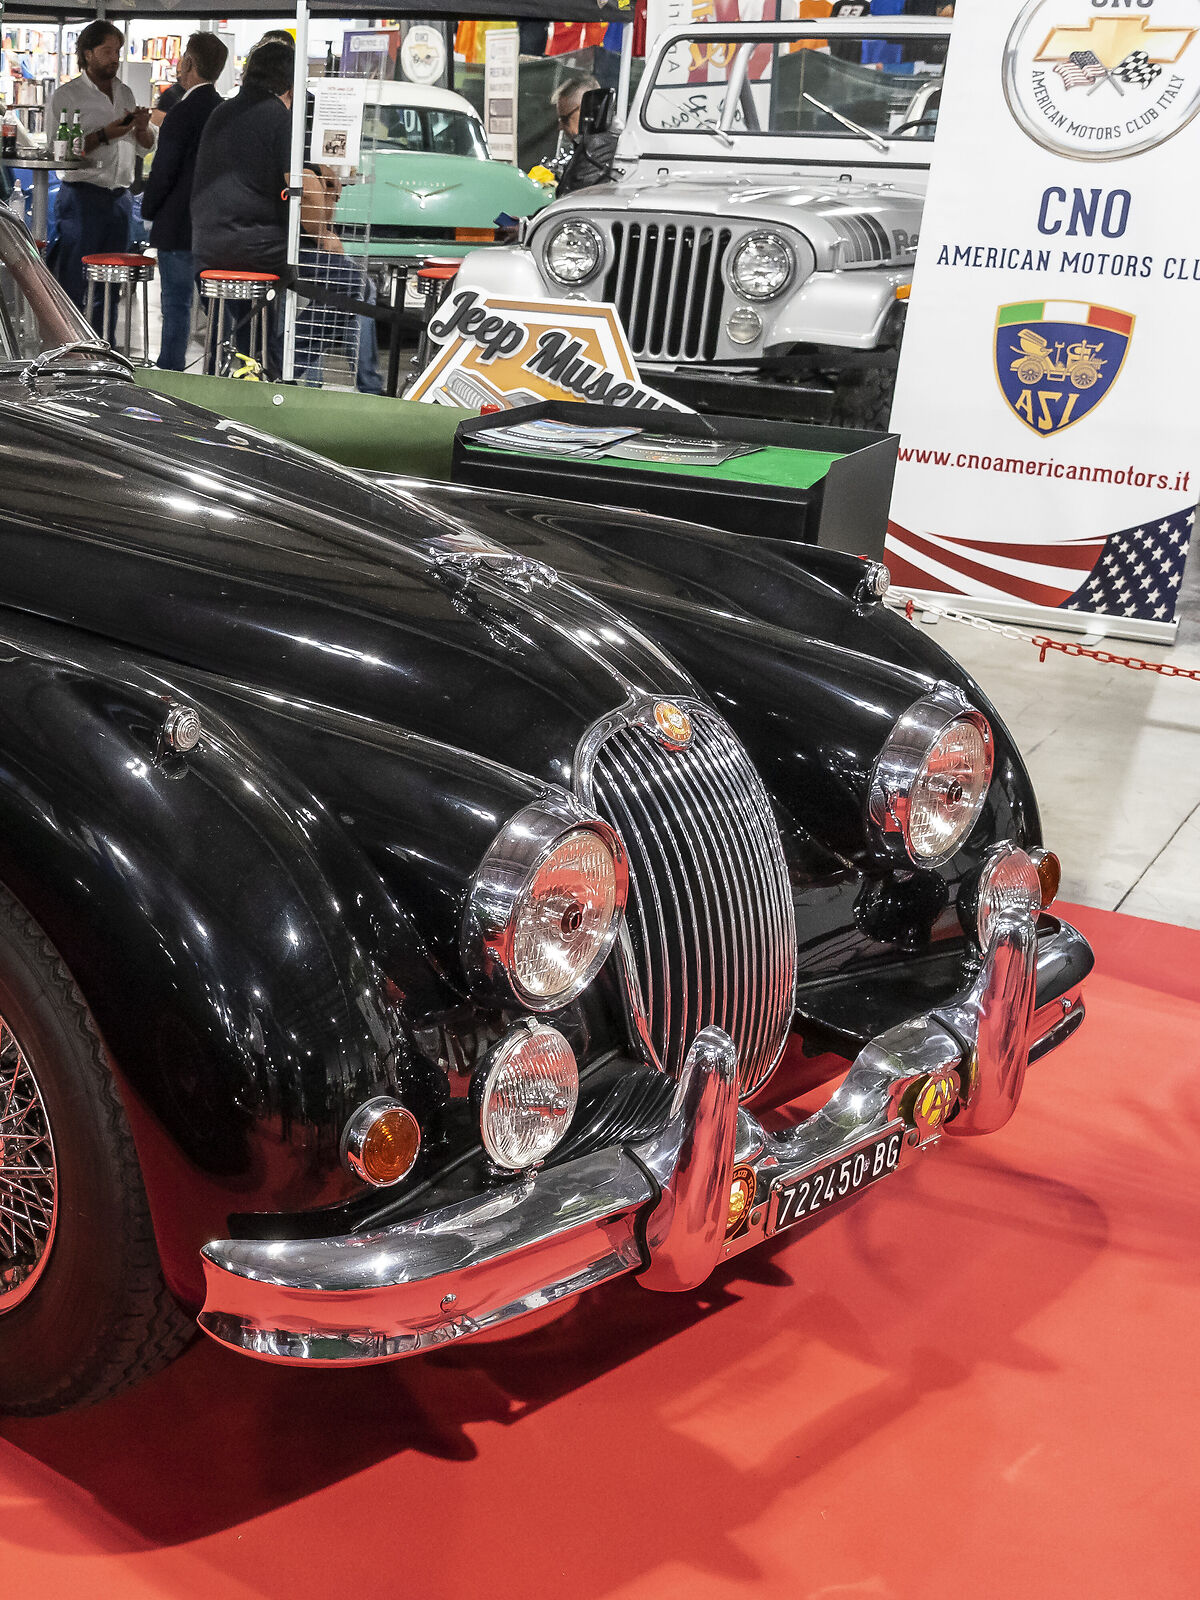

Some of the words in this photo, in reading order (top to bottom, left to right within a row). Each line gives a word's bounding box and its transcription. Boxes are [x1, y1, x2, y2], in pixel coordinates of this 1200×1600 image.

[1031, 70, 1067, 128] AMERICAN
[1066, 121, 1121, 140] MOTORS
[1125, 108, 1159, 134] CLUB
[1156, 74, 1185, 110] ITALY
[1037, 186, 1132, 239] CNO
[937, 245, 1050, 272] AMERICAN
[1060, 251, 1153, 278] MOTORS
[429, 291, 525, 360] Jeep
[1015, 389, 1080, 430] ASI
[897, 447, 1190, 492] www.cnoamericanmotors.it
[779, 1153, 865, 1226] 722450
[872, 1135, 899, 1177] BG
